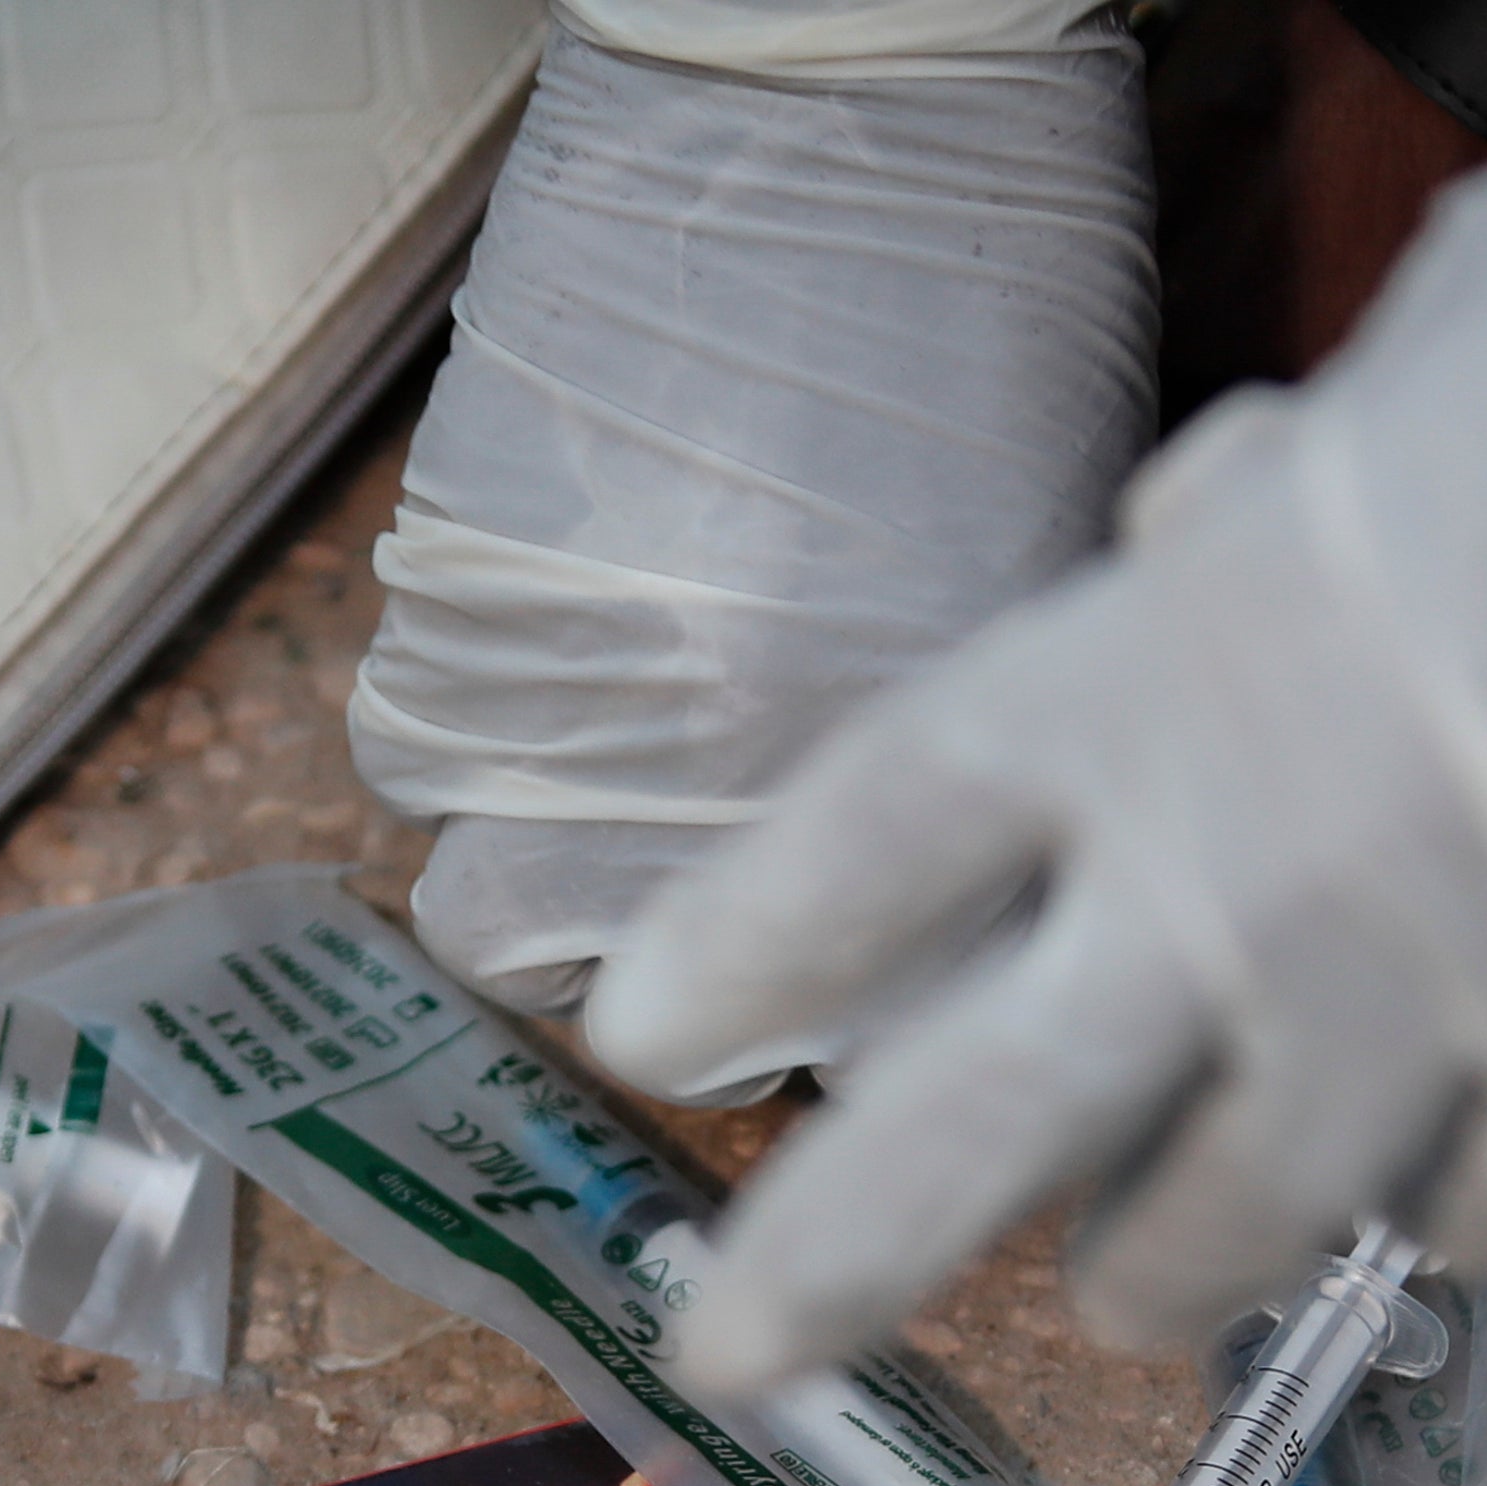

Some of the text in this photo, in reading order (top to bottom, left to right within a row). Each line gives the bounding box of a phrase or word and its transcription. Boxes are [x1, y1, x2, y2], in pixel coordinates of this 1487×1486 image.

[471, 1185, 579, 1213] 3
[549, 1295, 634, 1370] Needle
[1273, 1427, 1309, 1481] USE
